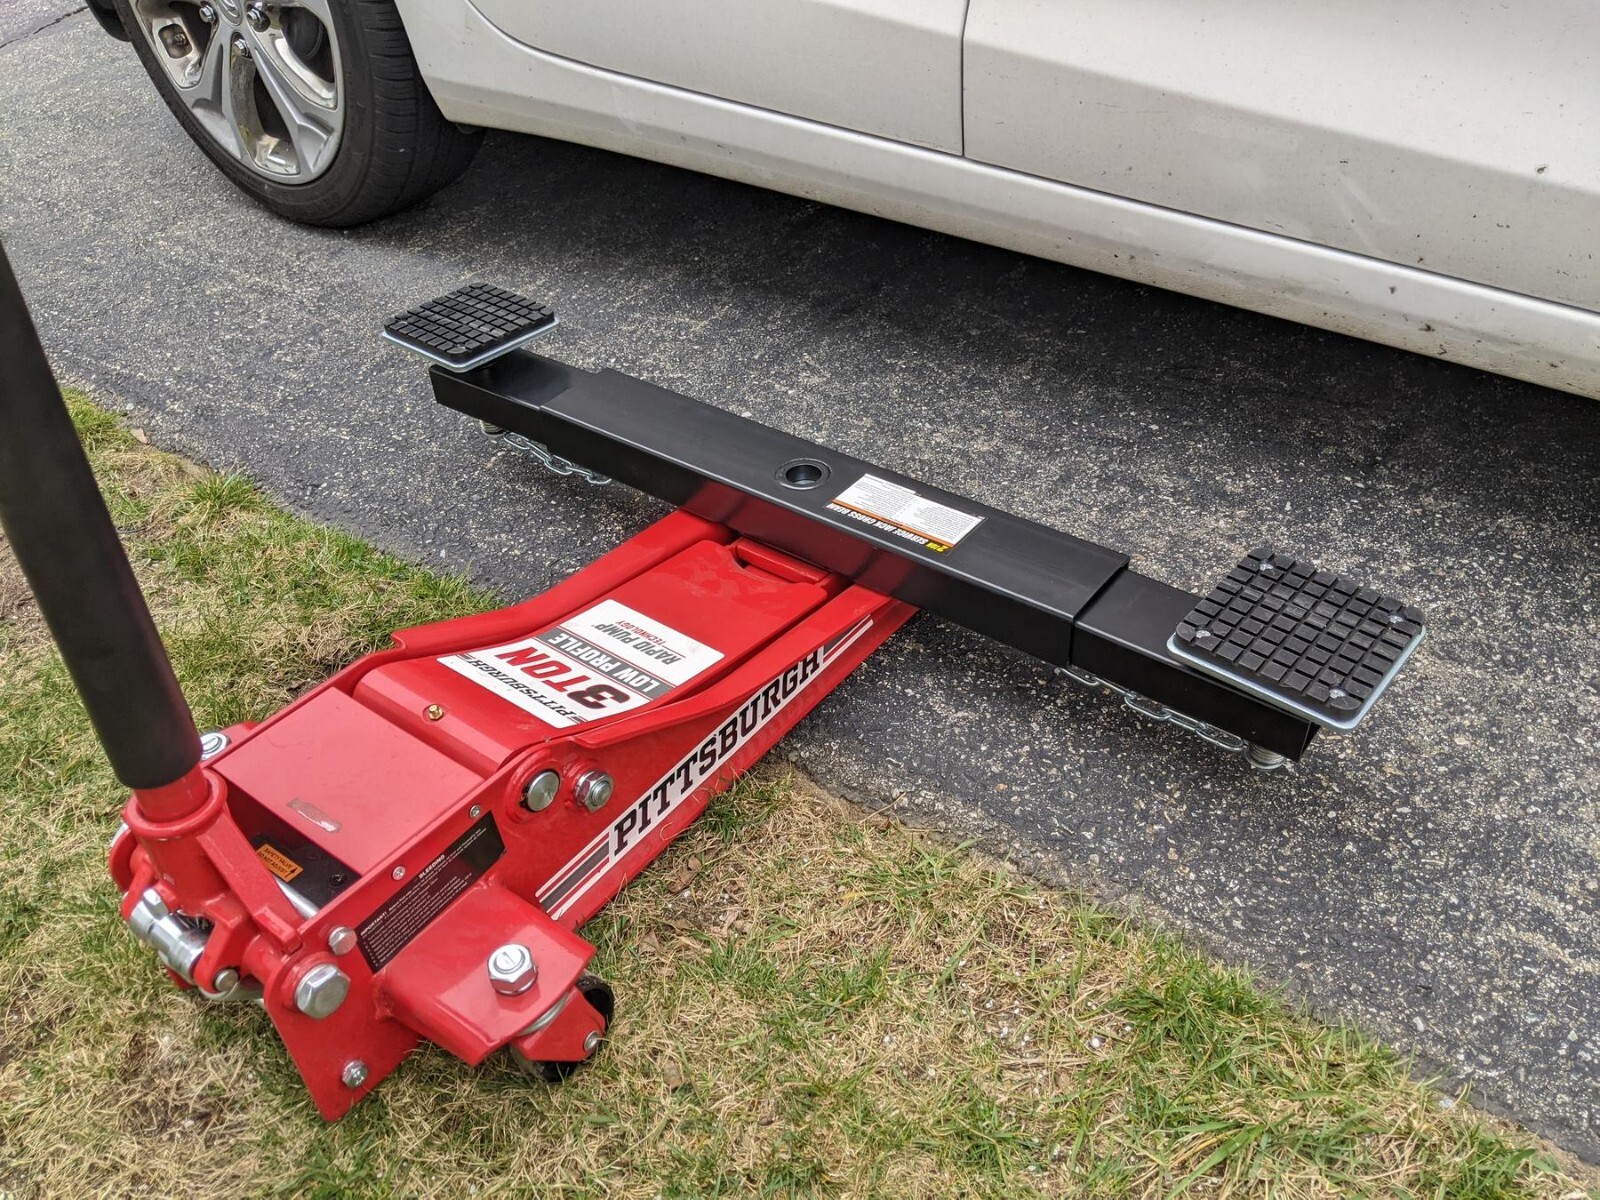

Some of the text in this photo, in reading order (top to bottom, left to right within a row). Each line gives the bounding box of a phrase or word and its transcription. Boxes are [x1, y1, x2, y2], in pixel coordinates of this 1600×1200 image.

[826, 503, 850, 515] BEAM
[848, 511, 875, 524] CROSS
[873, 521, 896, 532] JACK
[892, 529, 927, 544] SERVICE
[595, 622, 681, 665] RAPID PUMP
[615, 620, 667, 646] TECHNOLOGY
[546, 633, 660, 693] LOW PROFILE
[469, 652, 575, 718] PITTSBURGH
[494, 646, 631, 710] 3 TON
[613, 649, 820, 857] PITTSBURGH
[264, 848, 280, 860] SAFETY
[419, 854, 445, 879] BLEEDING
